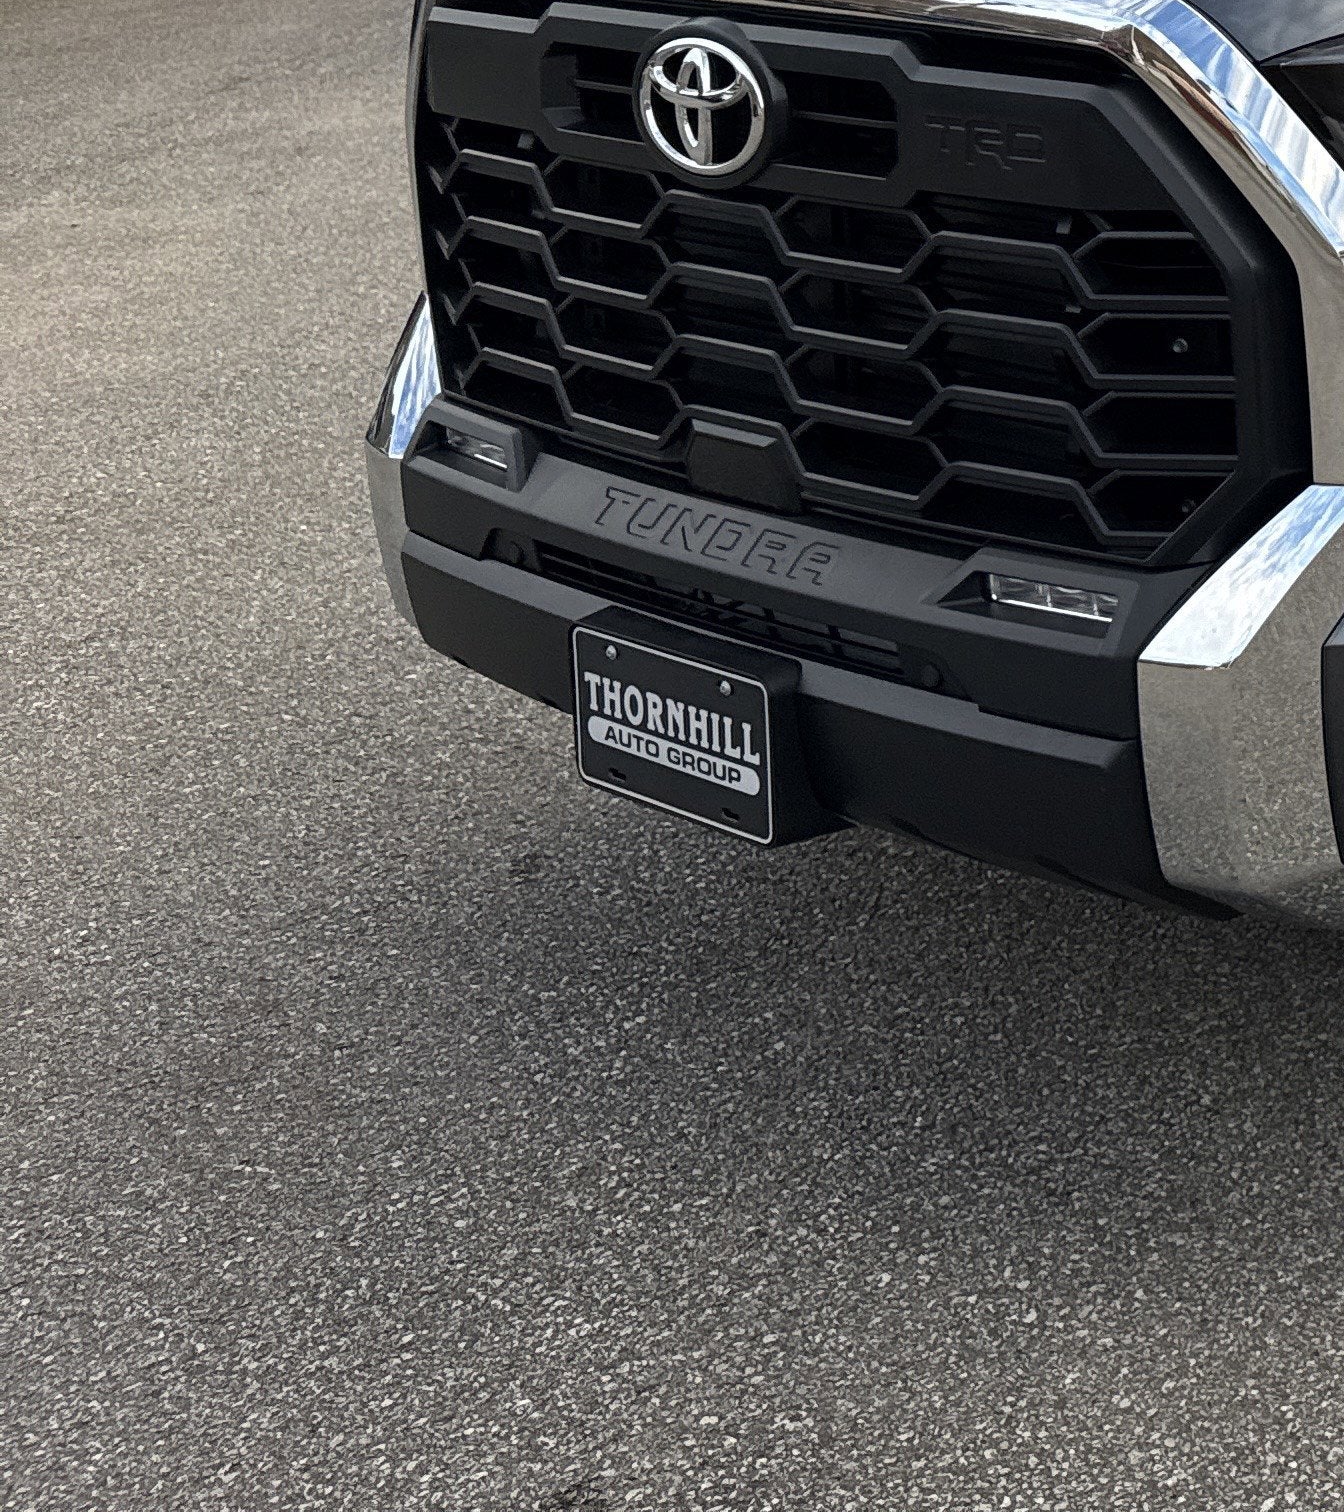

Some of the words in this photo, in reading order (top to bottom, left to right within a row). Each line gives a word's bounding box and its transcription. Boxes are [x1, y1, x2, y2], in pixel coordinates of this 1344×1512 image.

[924, 114, 1046, 172] TRD
[594, 486, 842, 587] TUNDRA
[583, 671, 761, 766] THORNHILL
[604, 725, 660, 759] AUTO
[666, 747, 742, 785] GROUP
